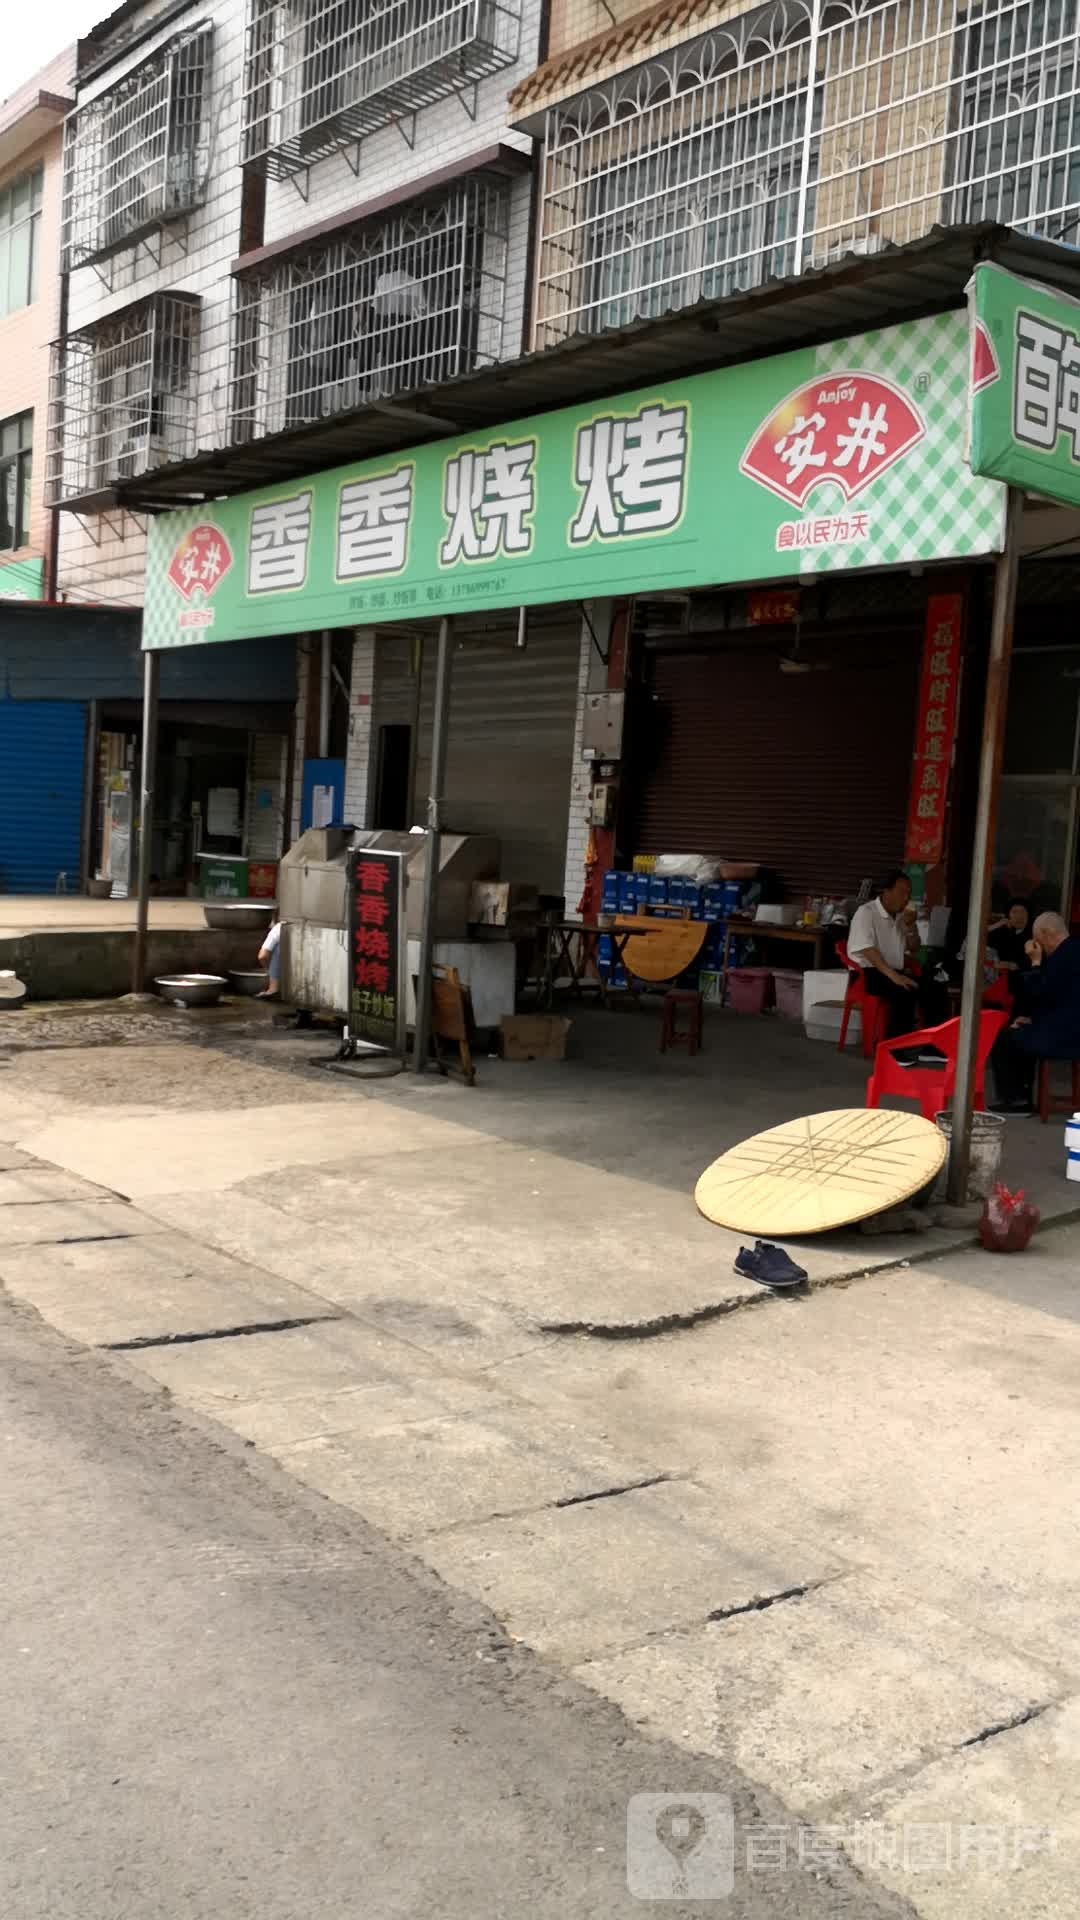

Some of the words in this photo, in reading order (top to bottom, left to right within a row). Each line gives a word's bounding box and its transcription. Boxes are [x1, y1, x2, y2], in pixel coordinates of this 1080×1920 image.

[817, 381, 858, 405] Anjoy
[773, 401, 890, 486] 安井
[247, 402, 688, 596] 香香烧烤
[777, 513, 870, 548] 食以民为天
[179, 541, 222, 589] 安井
[355, 861, 391, 993] 香香烧烤
